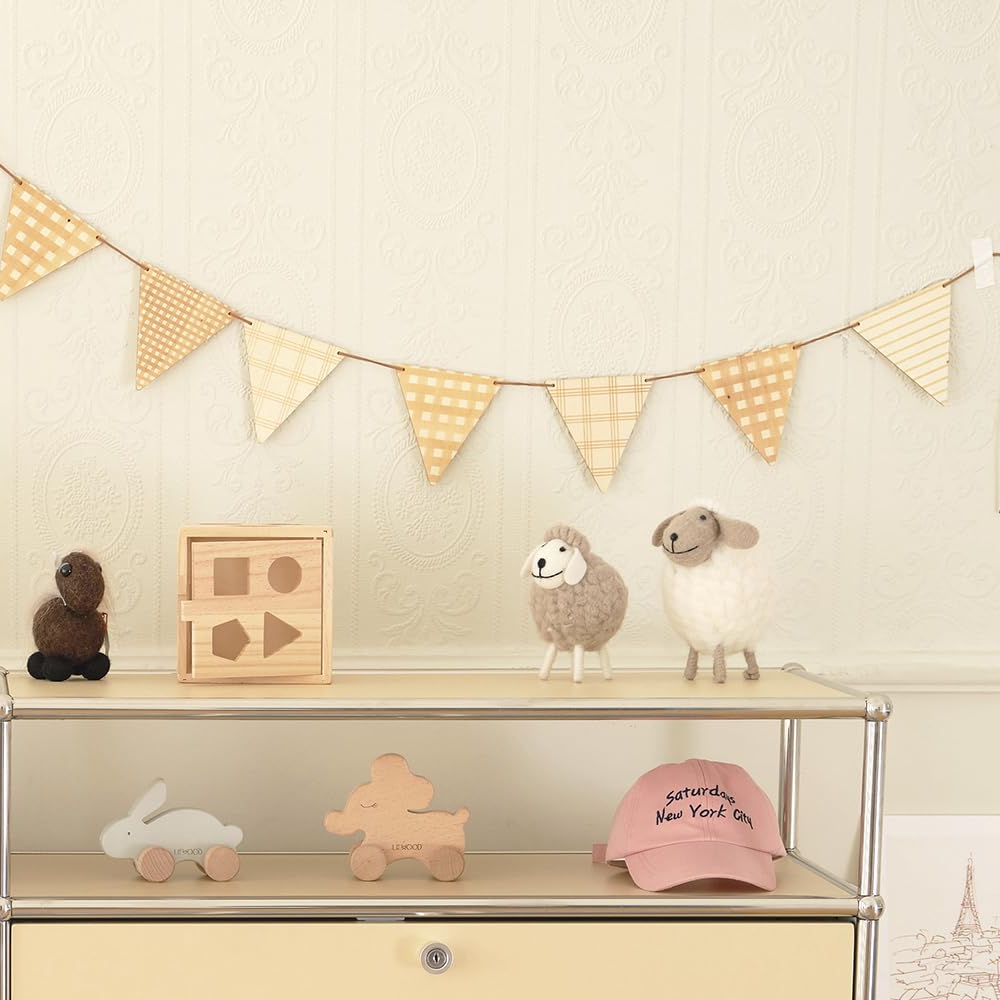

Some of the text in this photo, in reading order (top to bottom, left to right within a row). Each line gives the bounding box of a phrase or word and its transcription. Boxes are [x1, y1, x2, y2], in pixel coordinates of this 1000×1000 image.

[656, 804, 754, 830] New York City
